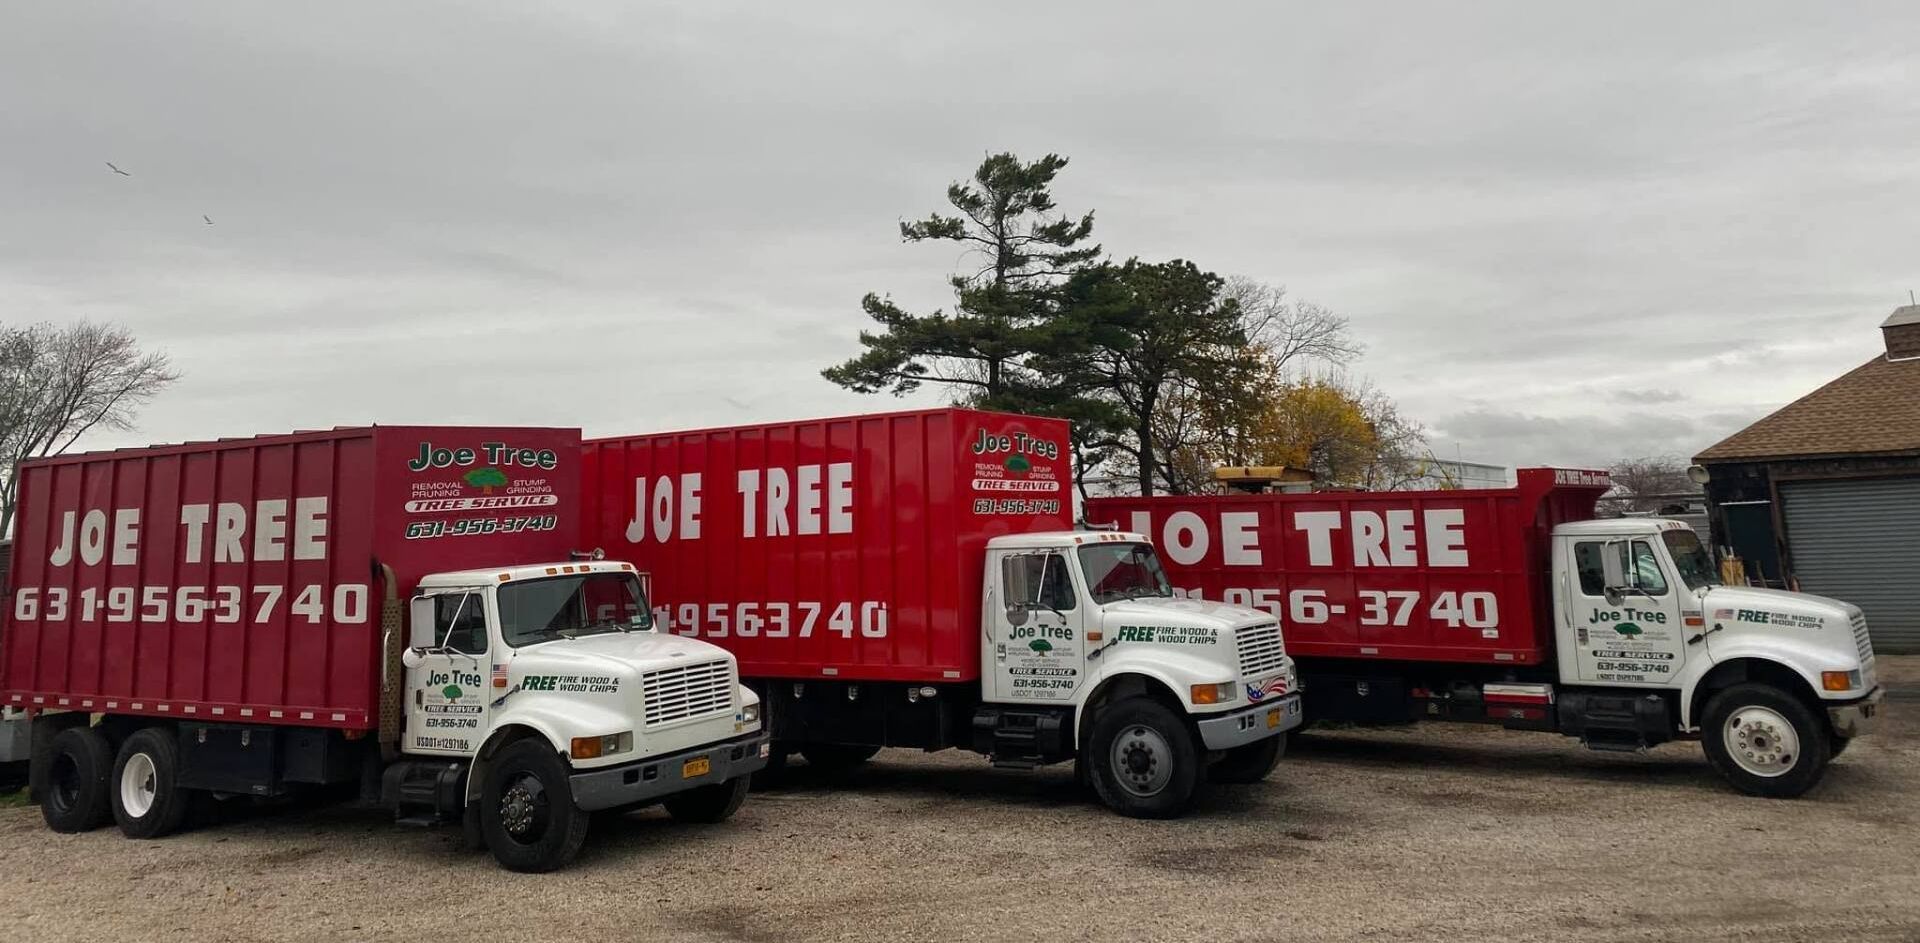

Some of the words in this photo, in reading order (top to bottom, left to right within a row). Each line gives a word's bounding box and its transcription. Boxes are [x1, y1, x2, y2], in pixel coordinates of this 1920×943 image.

[972, 428, 1011, 454] Joe
[1014, 432, 1057, 460] Tree
[408, 442, 475, 471] Joe
[482, 442, 557, 470] Tree
[412, 482, 463, 490] REMOVAL
[507, 486, 552, 494] GRINDING
[513, 479, 546, 487] STUMP
[977, 480, 1006, 489] TREE
[1009, 481, 1054, 490] SERVICE
[412, 490, 460, 498] PRUNING
[413, 499, 466, 511] TREE
[471, 496, 549, 508] SERVICE
[625, 472, 701, 543] JOE
[738, 462, 852, 538] TREE
[973, 498, 1060, 514] 631-956-3740
[50, 508, 140, 567] JOE
[181, 496, 328, 564] TREE
[405, 515, 557, 539] 631-956-3740
[1294, 508, 1469, 567] TREE
[15, 584, 368, 624] 631-956-3740
[1589, 608, 1620, 623] Joe
[1624, 608, 1666, 624] Tree
[1737, 609, 1770, 624] FREE
[1792, 614, 1816, 623] WOOD
[1771, 619, 1795, 627] WOOD
[1798, 621, 1823, 629] CHIPS
[1009, 625, 1035, 640] Joe
[1038, 624, 1073, 640] Tree
[1118, 626, 1155, 642] FREE
[1180, 627, 1208, 636] WOOD
[1211, 628, 1218, 636] &
[1158, 635, 1186, 643] WOOD
[1189, 636, 1217, 644] CHIPS
[1597, 662, 1669, 673] 631-956-3740
[426, 670, 449, 687] Joe
[452, 670, 481, 687] Tree
[521, 675, 558, 691] FREE
[558, 676, 579, 684] FIRE
[581, 676, 610, 685] WOOD
[612, 677, 620, 685] &
[1013, 679, 1073, 689] 631-956-3740
[560, 683, 587, 692] WOOD
[589, 684, 618, 693] CHIPS
[426, 718, 477, 728] 631-956-3740
